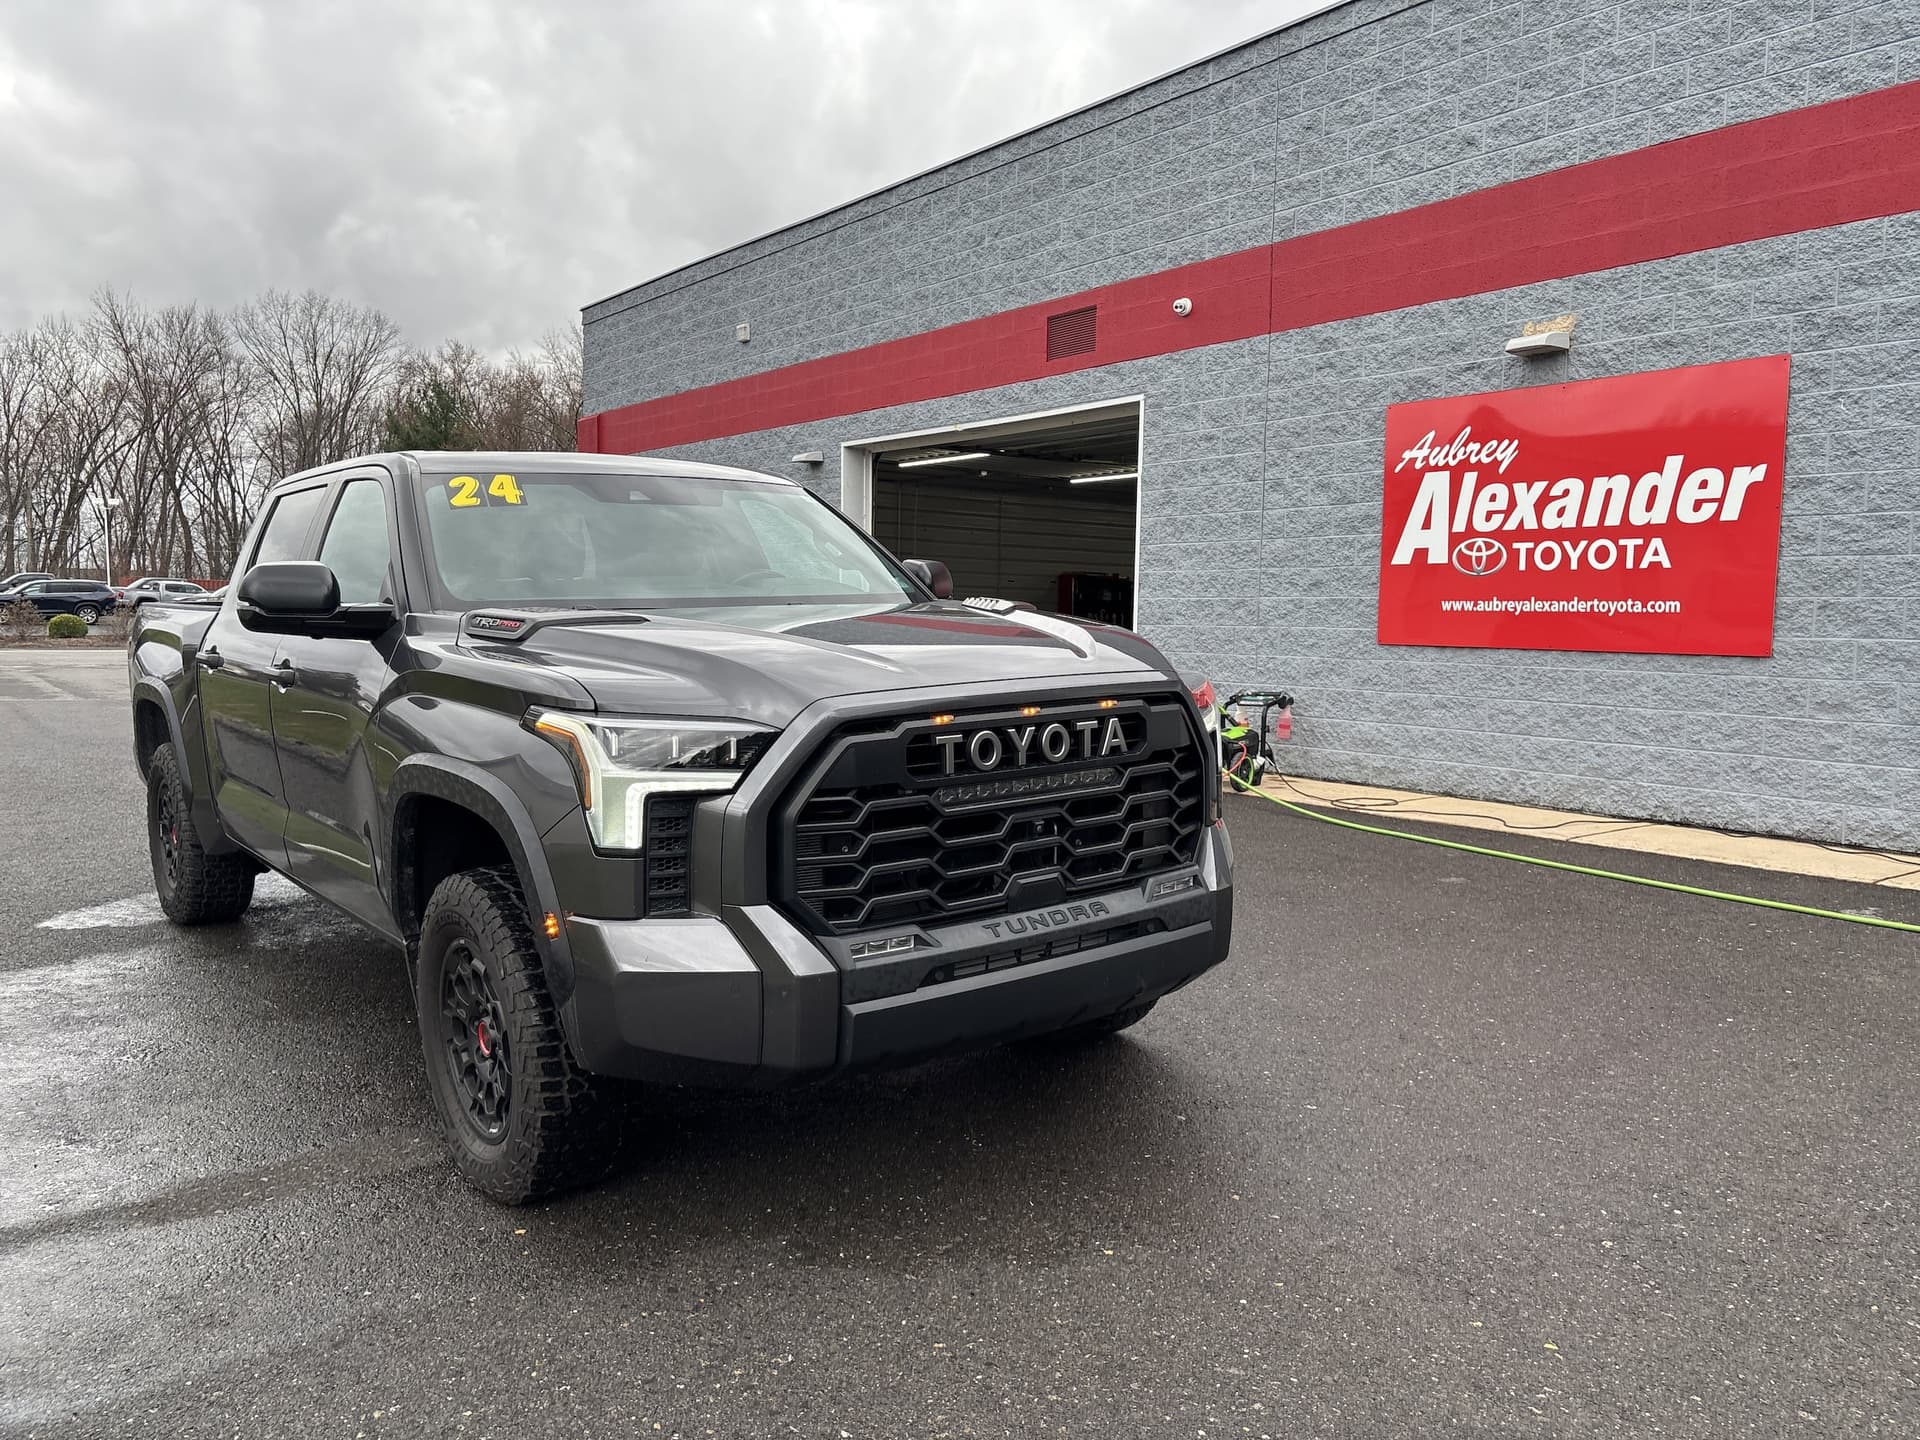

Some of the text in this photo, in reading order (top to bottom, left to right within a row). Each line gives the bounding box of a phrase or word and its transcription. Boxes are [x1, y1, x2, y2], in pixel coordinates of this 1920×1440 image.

[1395, 425, 1520, 474] Aubrey
[1391, 454, 1768, 566] Alexander
[1512, 537, 1672, 571] TOYOTA
[1441, 596, 1681, 617] www.aubreyalexandertoyota.com
[935, 717, 1128, 776] TOYOTA
[983, 901, 1110, 938] TUNDRA
